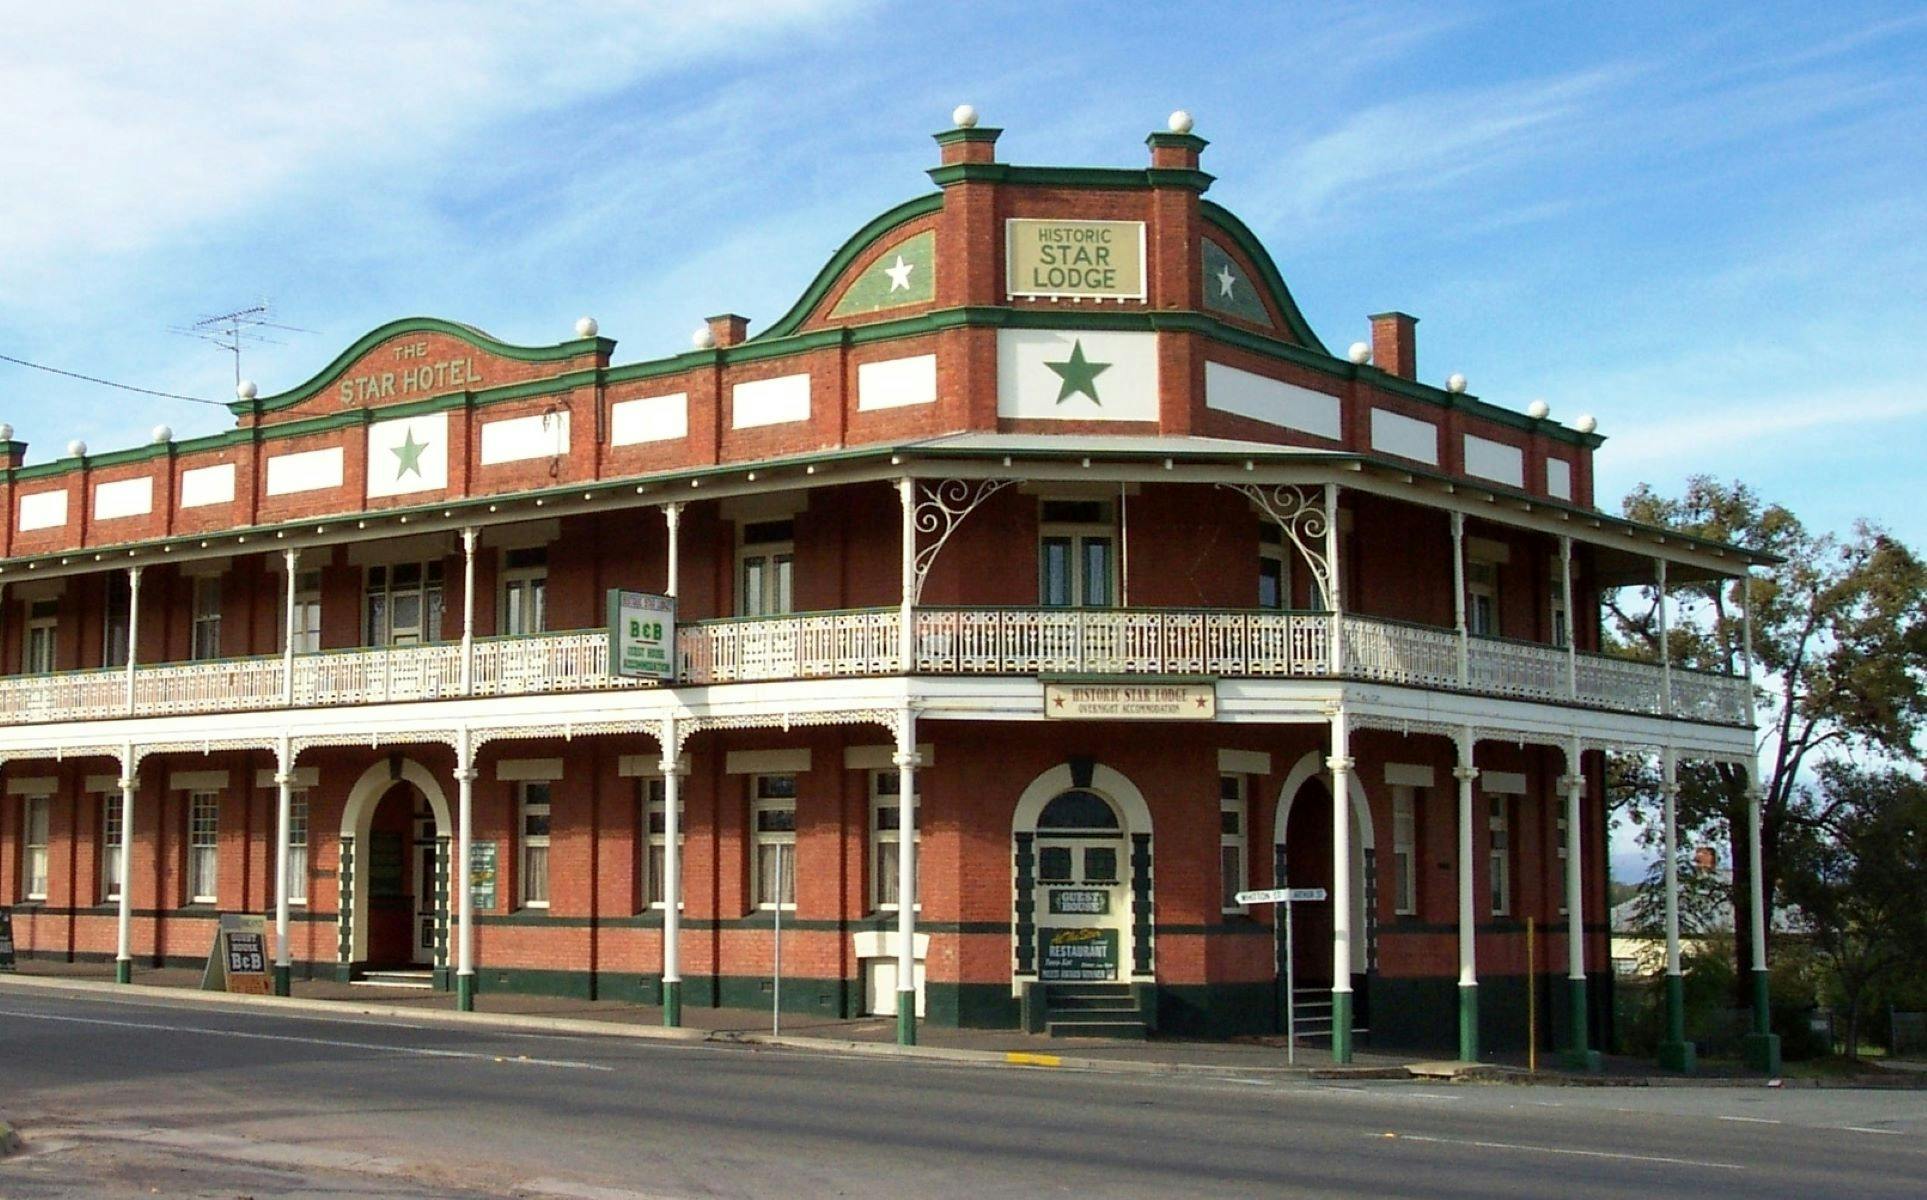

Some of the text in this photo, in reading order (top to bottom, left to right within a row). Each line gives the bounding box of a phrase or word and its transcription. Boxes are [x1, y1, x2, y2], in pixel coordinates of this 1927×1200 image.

[1038, 228, 1112, 244] HISTORIC
[1040, 244, 1110, 266] STAR
[1033, 267, 1116, 289] LODGE
[393, 341, 429, 361] THE
[340, 356, 483, 403] STAR HOTEL
[1072, 687, 1188, 703] HISTORIC STAR LODGE
[1078, 703, 1119, 714] OVERNIGHT
[1061, 891, 1100, 903] GUEST
[1048, 944, 1108, 958] RESTAURANT
